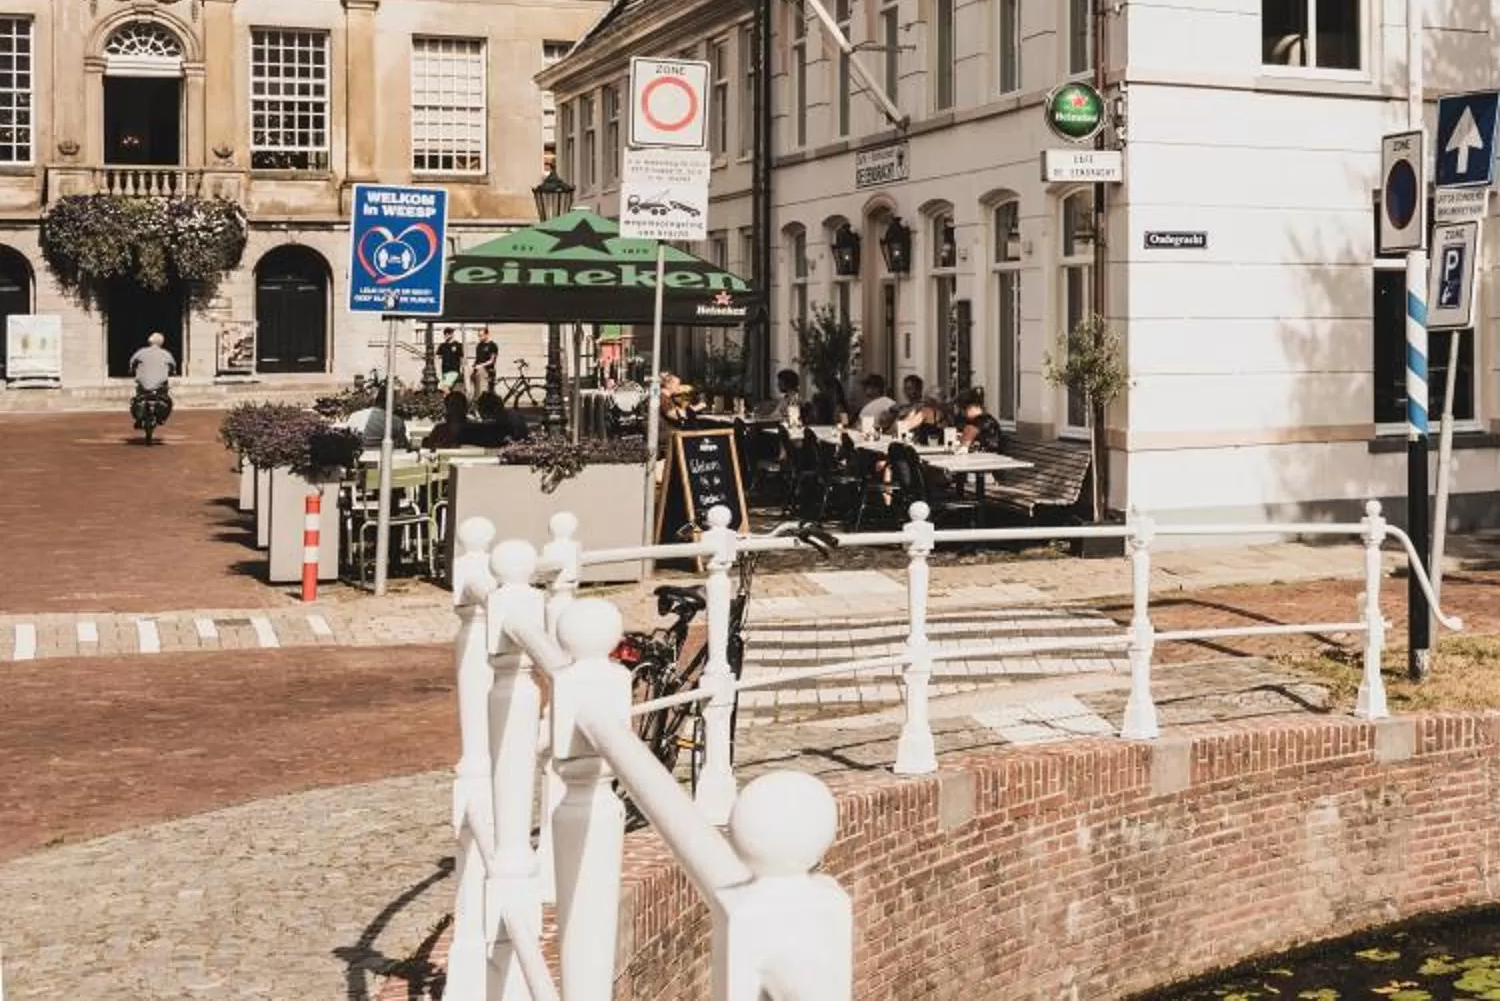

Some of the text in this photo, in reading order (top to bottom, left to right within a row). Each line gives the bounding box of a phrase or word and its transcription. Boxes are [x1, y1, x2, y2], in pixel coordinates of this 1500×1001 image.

[656, 64, 687, 76] ZONE
[367, 191, 436, 206] WELKOM
[382, 205, 437, 219] WEESP
[1150, 234, 1203, 246] Oudegracht
[1445, 229, 1465, 241] ZONE
[1445, 250, 1459, 281] P
[696, 305, 747, 317] Heineken
